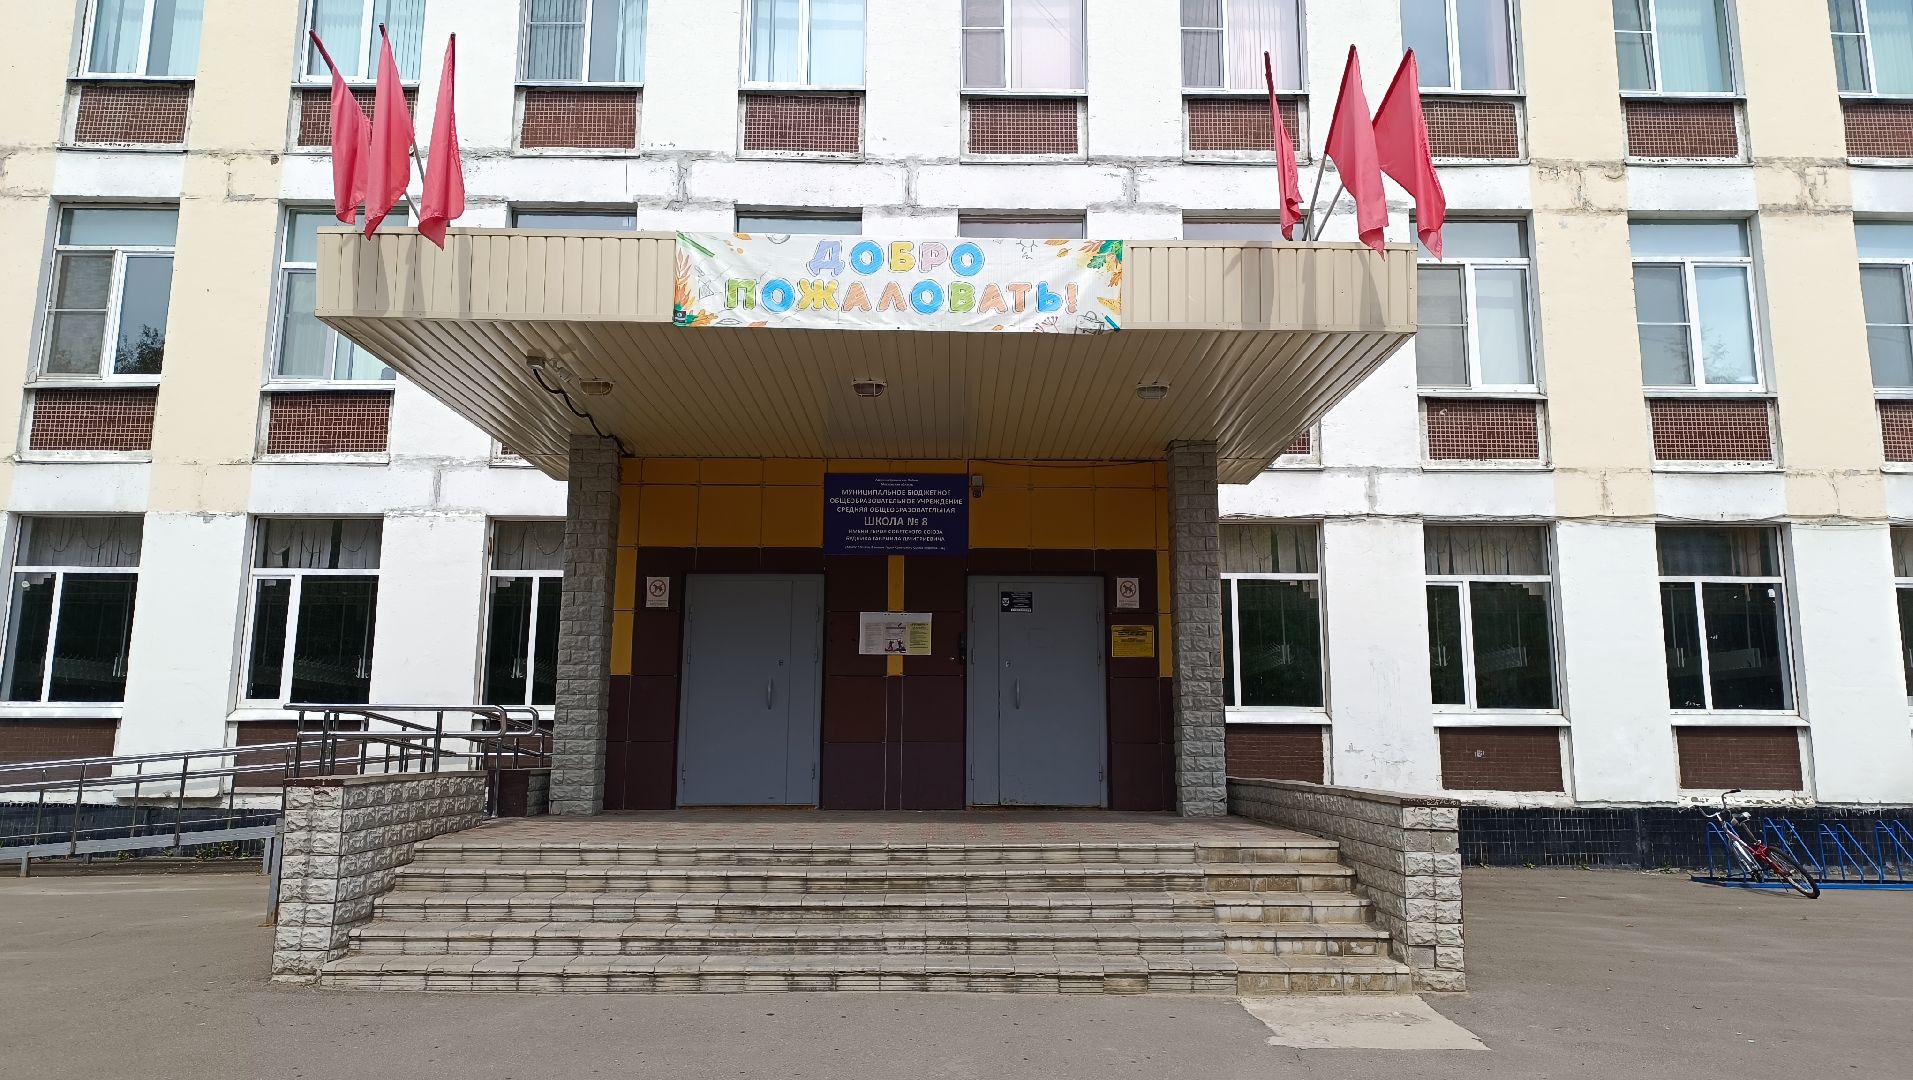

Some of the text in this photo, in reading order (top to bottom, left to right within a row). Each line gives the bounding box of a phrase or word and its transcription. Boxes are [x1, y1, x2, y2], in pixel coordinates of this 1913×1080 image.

[806, 239, 985, 277] ДОБРО
[724, 278, 1078, 315] ПОЖАЛОВАТЬ!
[907, 489, 951, 497] БЮДЖЕТНОЕ
[829, 497, 963, 506] ОБЩЕОБРАЗОВАТЕЛЬНОЕ УЧРЕЖДЕНИЕ
[836, 506, 956, 514] СРЕДНЯЯ ОБЩЕОБРАЗОВАТЕЛЬНАЯ
[864, 516, 928, 526] ШКОЛА № 8
